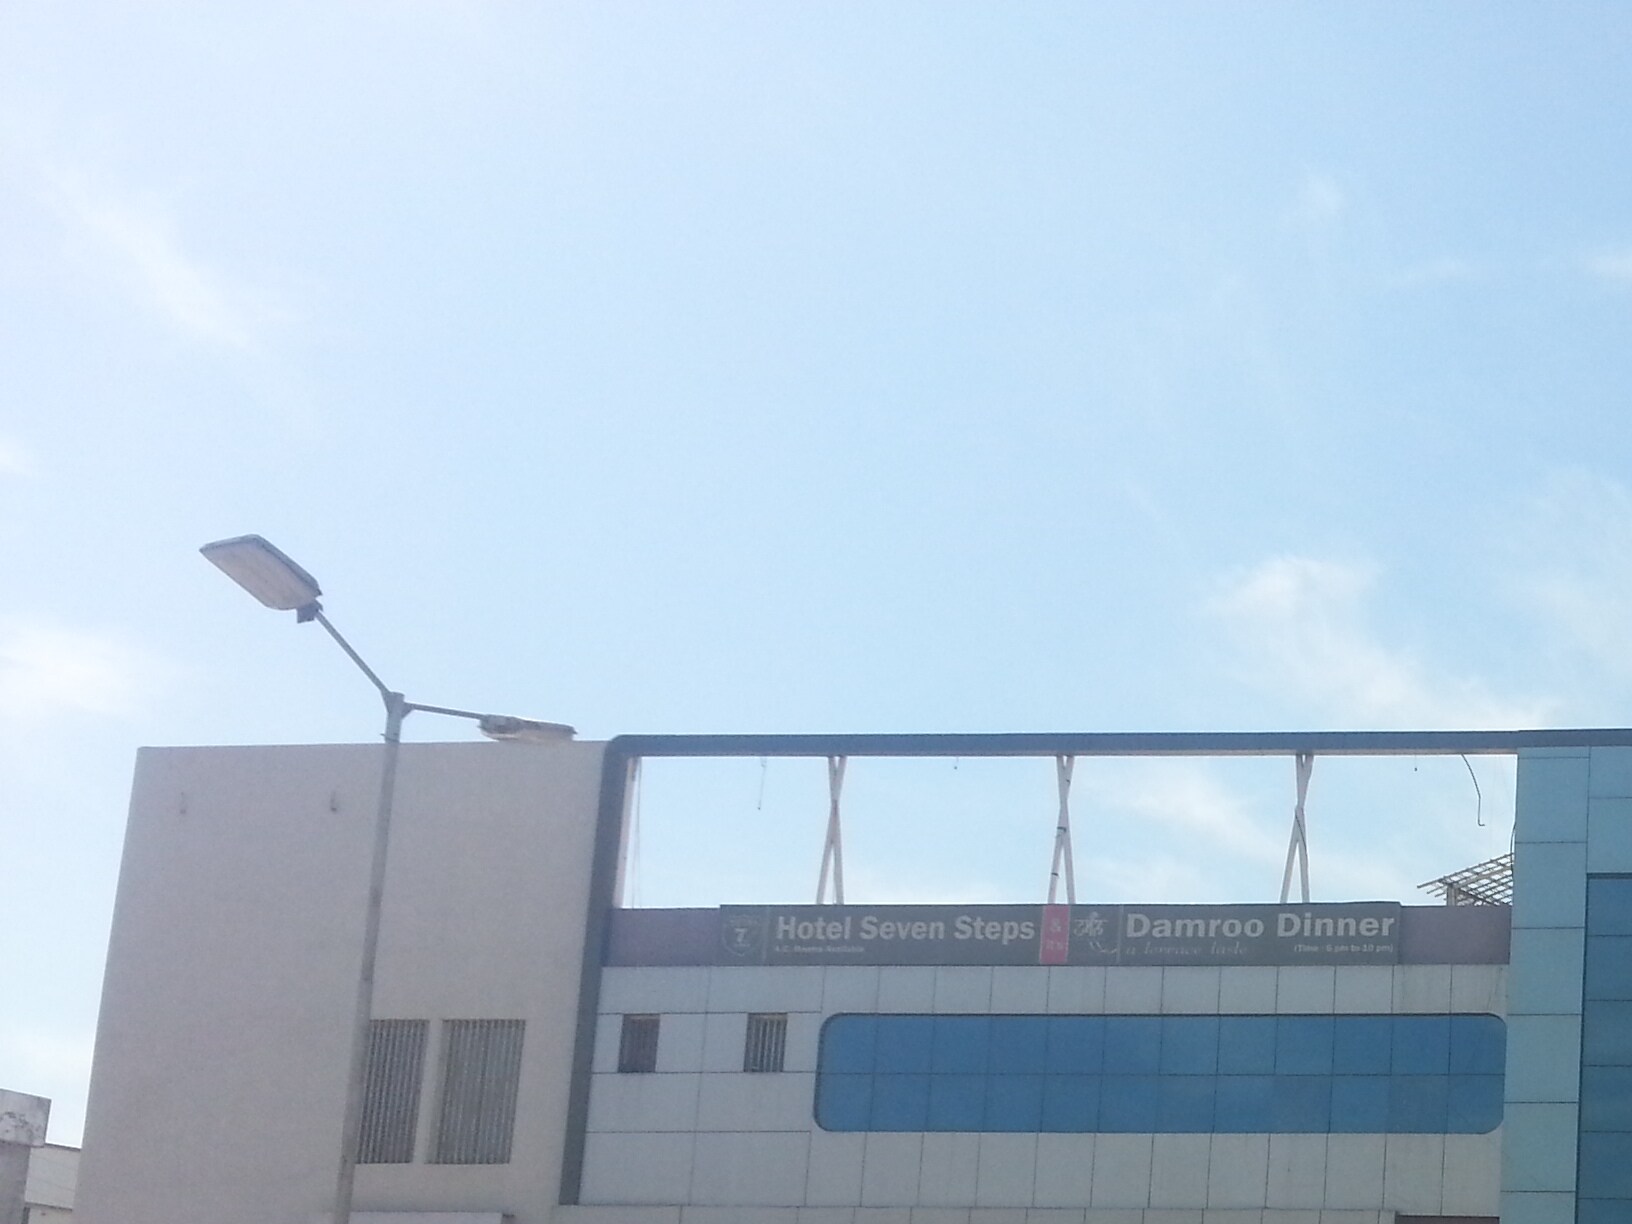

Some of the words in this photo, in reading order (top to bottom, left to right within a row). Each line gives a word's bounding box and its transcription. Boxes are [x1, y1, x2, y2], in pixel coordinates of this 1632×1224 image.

[776, 915, 851, 940] Hotel
[859, 915, 945, 940] Seven
[953, 914, 1036, 944] Steps
[1126, 913, 1266, 937] Damroo
[1277, 912, 1395, 937] Dinner
